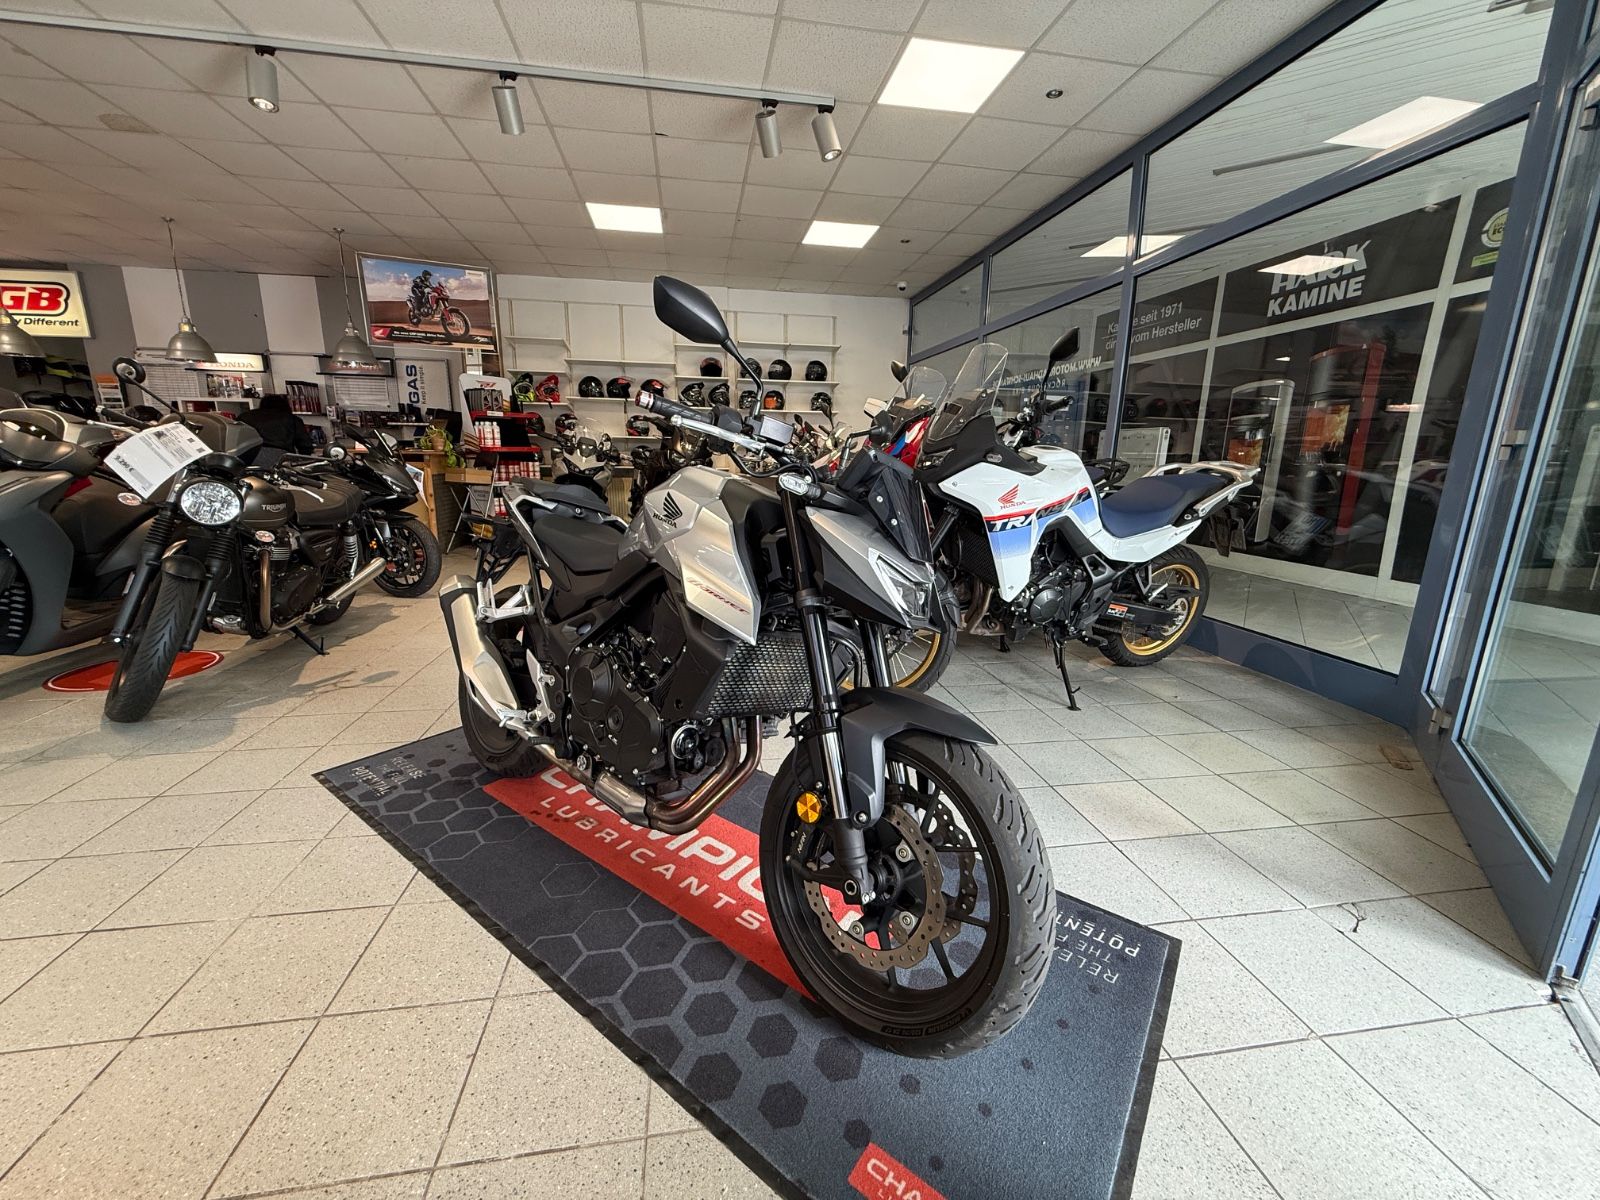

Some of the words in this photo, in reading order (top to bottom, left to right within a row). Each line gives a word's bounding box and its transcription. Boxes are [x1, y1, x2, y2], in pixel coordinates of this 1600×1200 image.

[1267, 275, 1366, 318] KAMINE
[24, 318, 80, 327] Different
[1140, 309, 1158, 324] seit
[1160, 301, 1183, 319] 1971
[1131, 331, 1150, 343] vom
[1151, 317, 1202, 338] Hersteller
[1000, 500, 1026, 510] HONDA
[652, 512, 677, 529] HONDA
[540, 796, 767, 930] LUBRICANTS
[1076, 939, 1112, 963] THE
